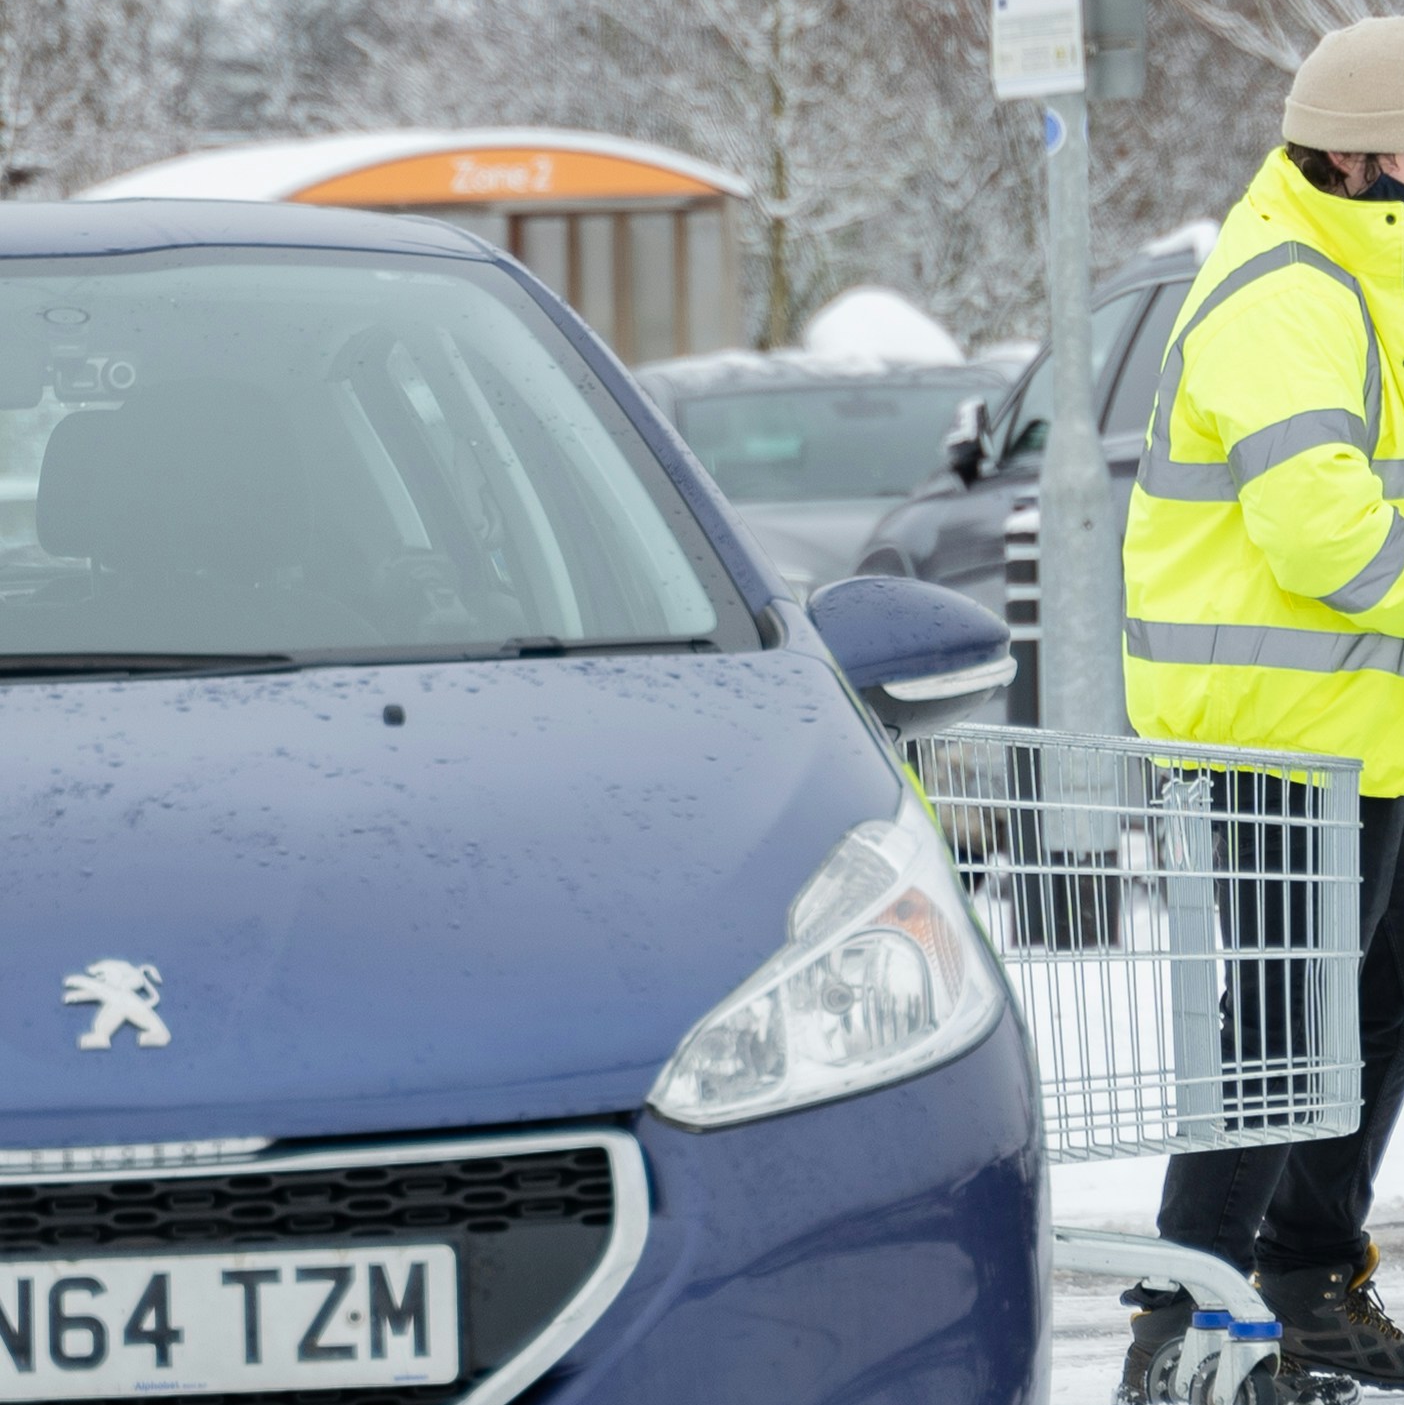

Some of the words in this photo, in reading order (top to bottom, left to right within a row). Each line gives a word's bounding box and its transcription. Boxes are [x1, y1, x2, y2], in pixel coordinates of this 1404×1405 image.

[451, 155, 530, 195] Zone
[533, 154, 552, 193] 2
[221, 1261, 430, 1365] TZM
